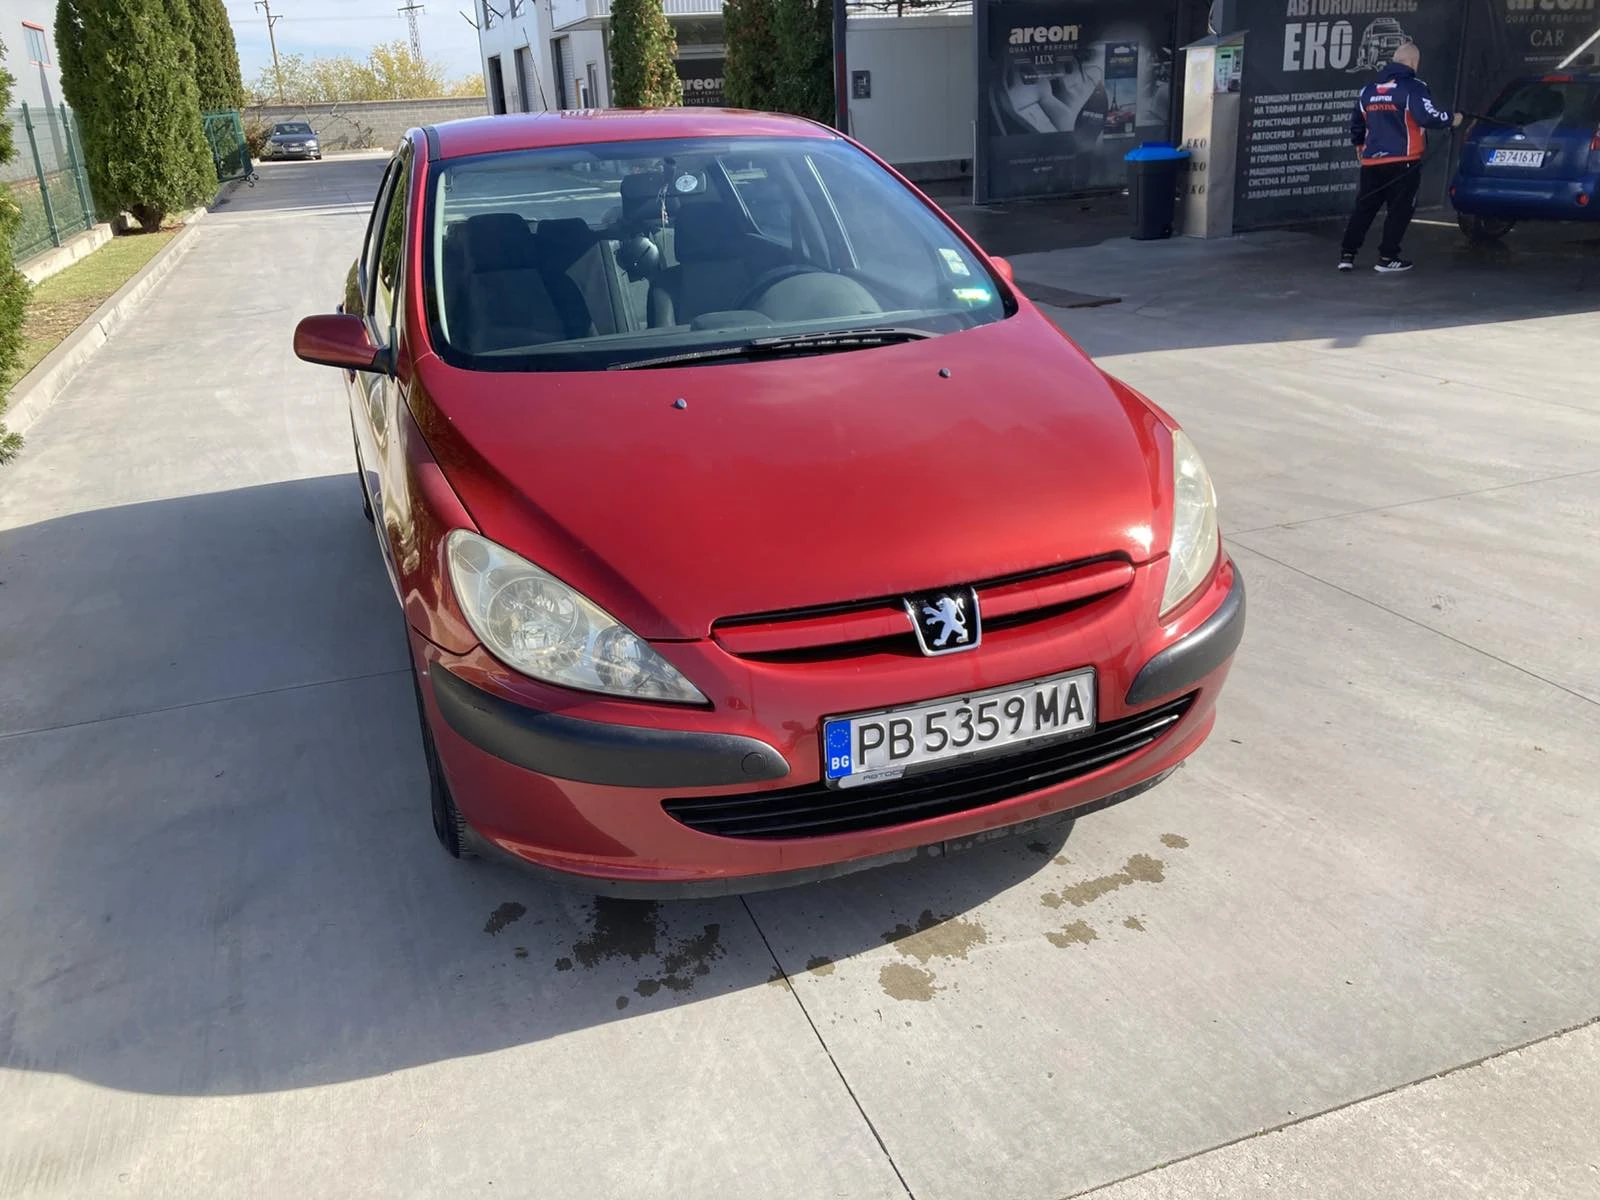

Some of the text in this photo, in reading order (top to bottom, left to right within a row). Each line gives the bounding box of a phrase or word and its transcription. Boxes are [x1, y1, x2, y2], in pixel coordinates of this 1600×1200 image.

[1009, 25, 1078, 44] areon
[1530, 29, 1564, 47] CAR
[1034, 55, 1054, 65] LUX
[1254, 94, 1290, 104] ГОДИШНИ
[1291, 91, 1333, 102] ТЕХНИЧЕСКИ
[1254, 106, 1264, 115] НА
[1265, 104, 1297, 114] ТОВАРНИ
[1253, 116, 1301, 128] РЕГИСТРАЦИЯ
[1301, 115, 1311, 124] НА
[1251, 129, 1295, 141] АВТОСЕРВИЗ
[1302, 126, 1343, 136] АВТОМИВКА
[1288, 140, 1331, 150] ПОЧИСТВАНЕ
[1289, 150, 1320, 160] СИСТЕМА
[1286, 162, 1329, 173] ПОЧИСТВАНЕ
[1248, 177, 1279, 187] СИСТЕМА
[925, 696, 1026, 752] 5359
[831, 755, 849, 770] BG
